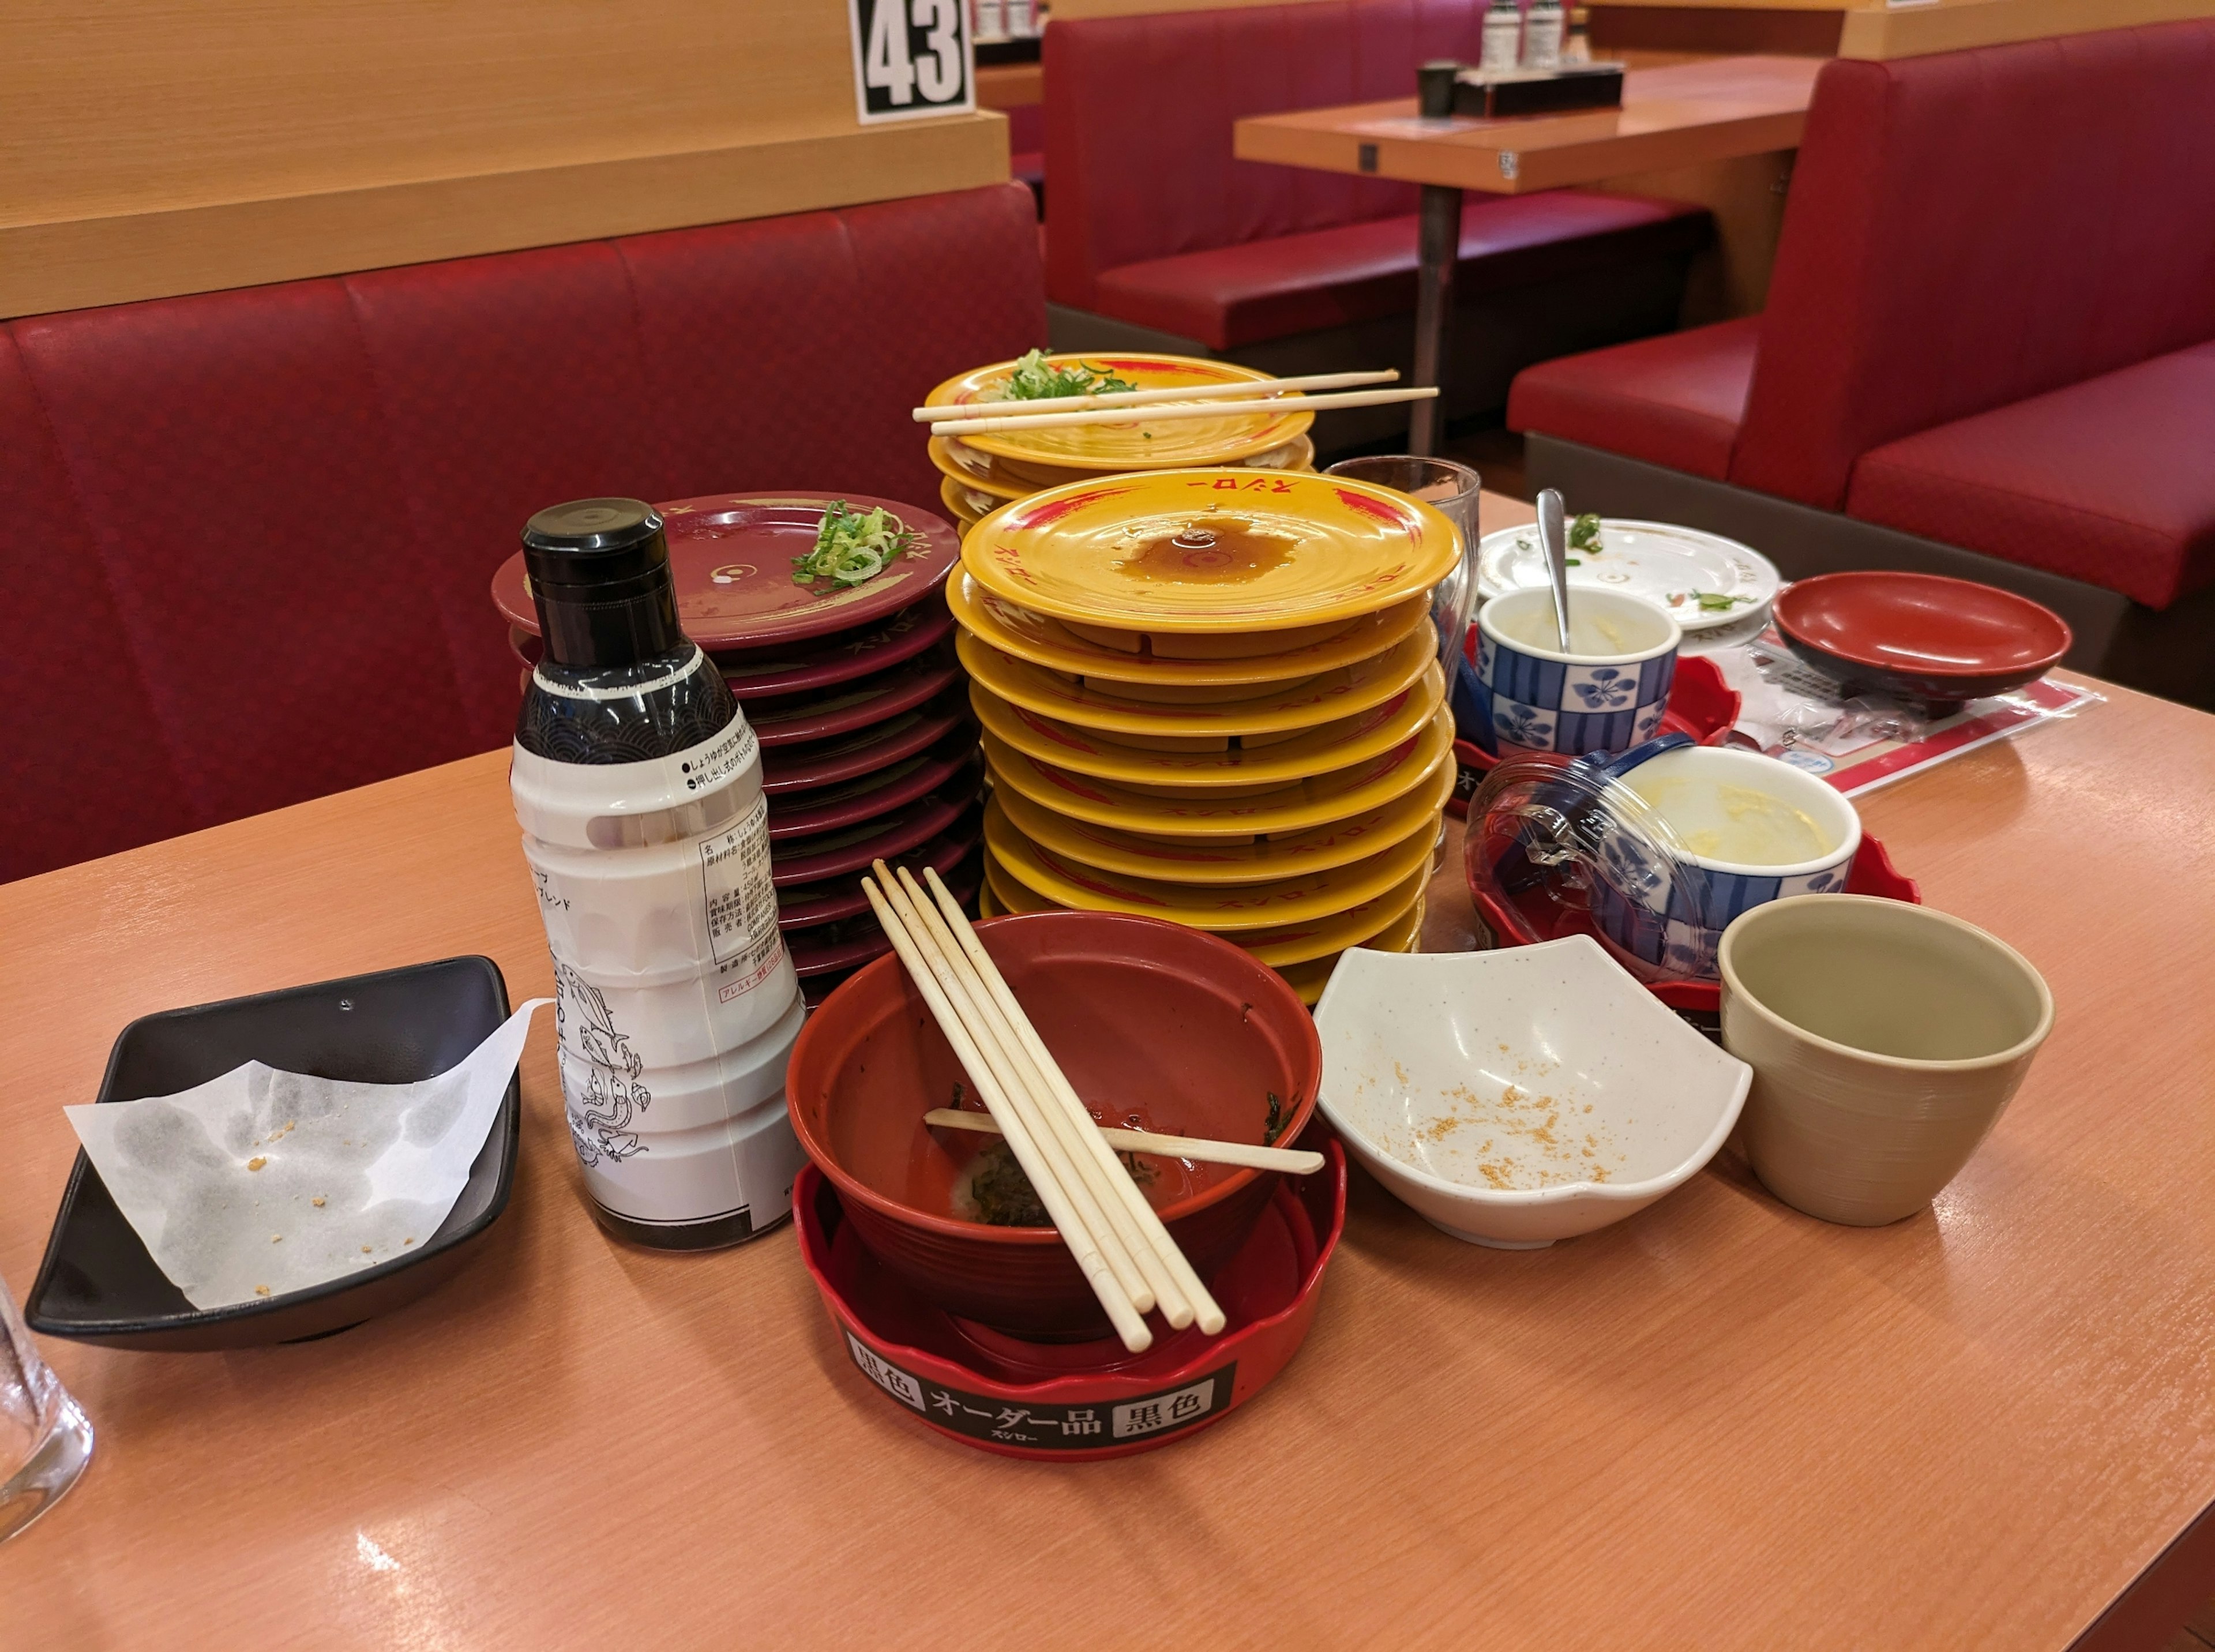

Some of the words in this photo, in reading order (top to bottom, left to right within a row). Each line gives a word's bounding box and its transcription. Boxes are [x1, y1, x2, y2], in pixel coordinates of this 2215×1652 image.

[866, 0, 960, 106] 43
[1186, 478, 1301, 493] スシロー
[993, 543, 1038, 585] スシロー
[1283, 816, 1383, 855] スシロー
[1215, 884, 1330, 910] スシロー
[857, 1345, 915, 1402] 黒色
[930, 1391, 1101, 1435] オーダー品
[1127, 1394, 1201, 1431] 黒色
[991, 1429, 1038, 1441] スシロー
